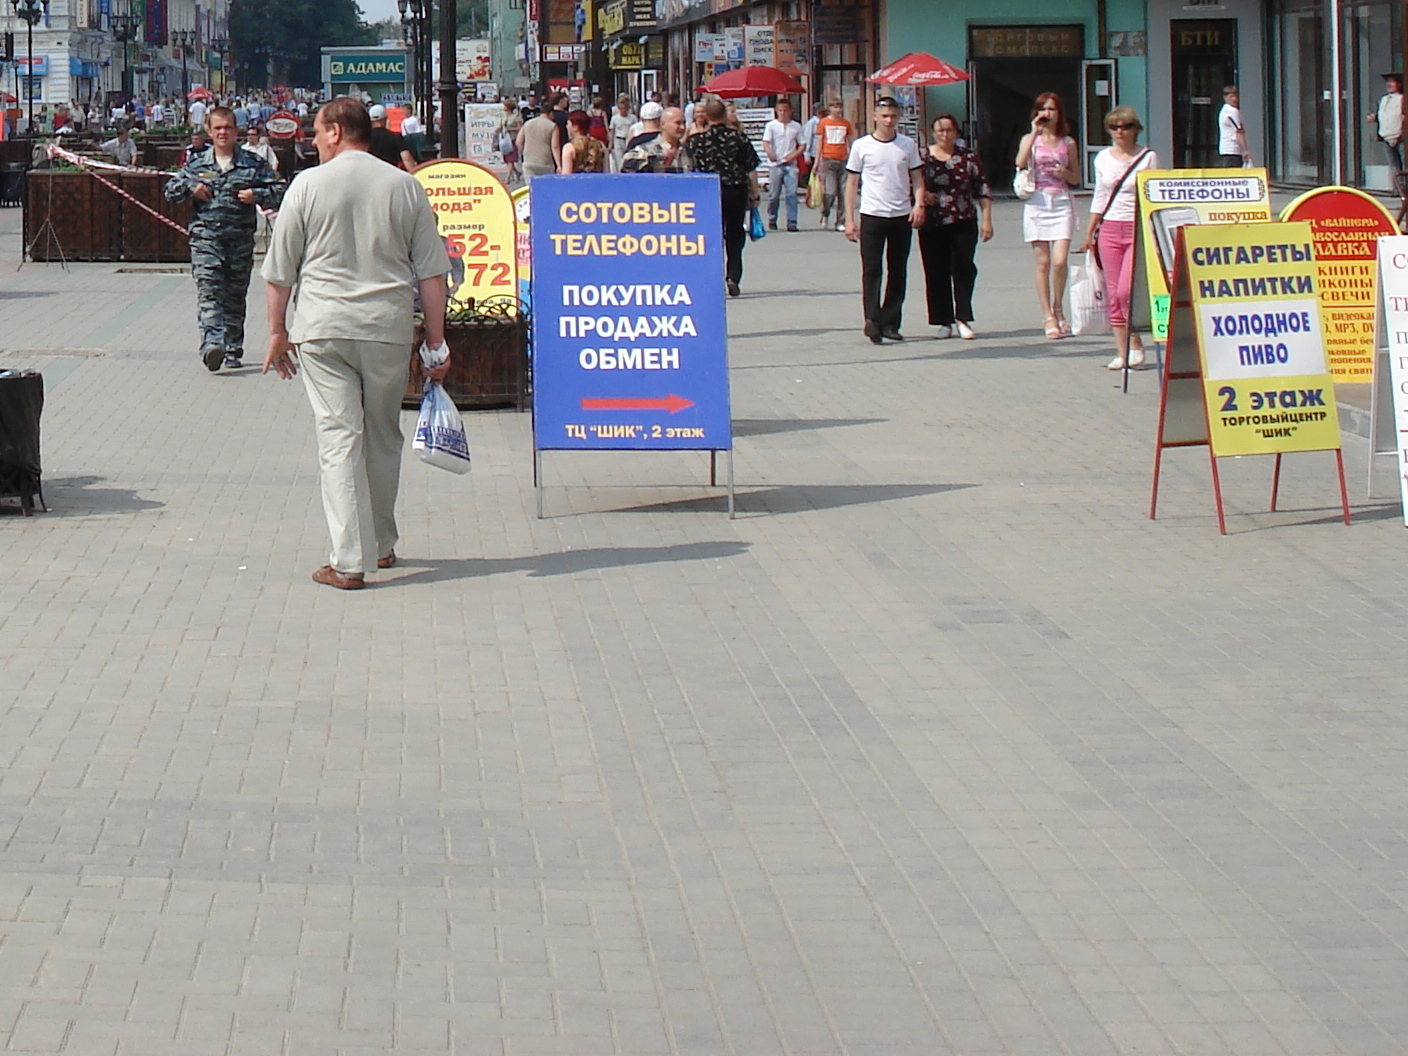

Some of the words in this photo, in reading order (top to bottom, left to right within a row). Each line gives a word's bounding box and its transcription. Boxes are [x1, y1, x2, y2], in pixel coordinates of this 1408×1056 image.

[1180, 31, 1220, 45] БТИ
[347, 62, 405, 74] АДАМАС
[425, 185, 494, 197] ольшая
[1159, 188, 1250, 200] ТЕЛЕФОНЫ
[559, 202, 696, 223] СОТОВЫЕ
[1208, 211, 1269, 223] покупка
[442, 223, 485, 232] размер
[447, 233, 502, 258] 52-
[549, 234, 705, 256] ТЕЛЕФОНЫ
[1192, 243, 1312, 266] СИГАРЕТЫ
[1314, 242, 1372, 256] ЛАВКА
[467, 262, 511, 286] 72
[1318, 266, 1369, 276] КНИГИ
[1198, 275, 1314, 298] НАПИТКИ
[1318, 278, 1373, 288] ИКОНЫ
[562, 284, 692, 306] ПОКУПКА
[1319, 291, 1371, 301] СВЕЧИ
[559, 315, 698, 341] ПРОДАЖА
[1211, 312, 1311, 337] ХОЛОДНОЕ
[579, 347, 680, 370] ОБМЕН
[1237, 343, 1289, 366] ПИВО
[1218, 386, 1238, 412] 2
[1249, 389, 1326, 411] этаж
[565, 425, 587, 439] ТЦ
[651, 425, 662, 438] 2
[665, 427, 705, 439] этаж
